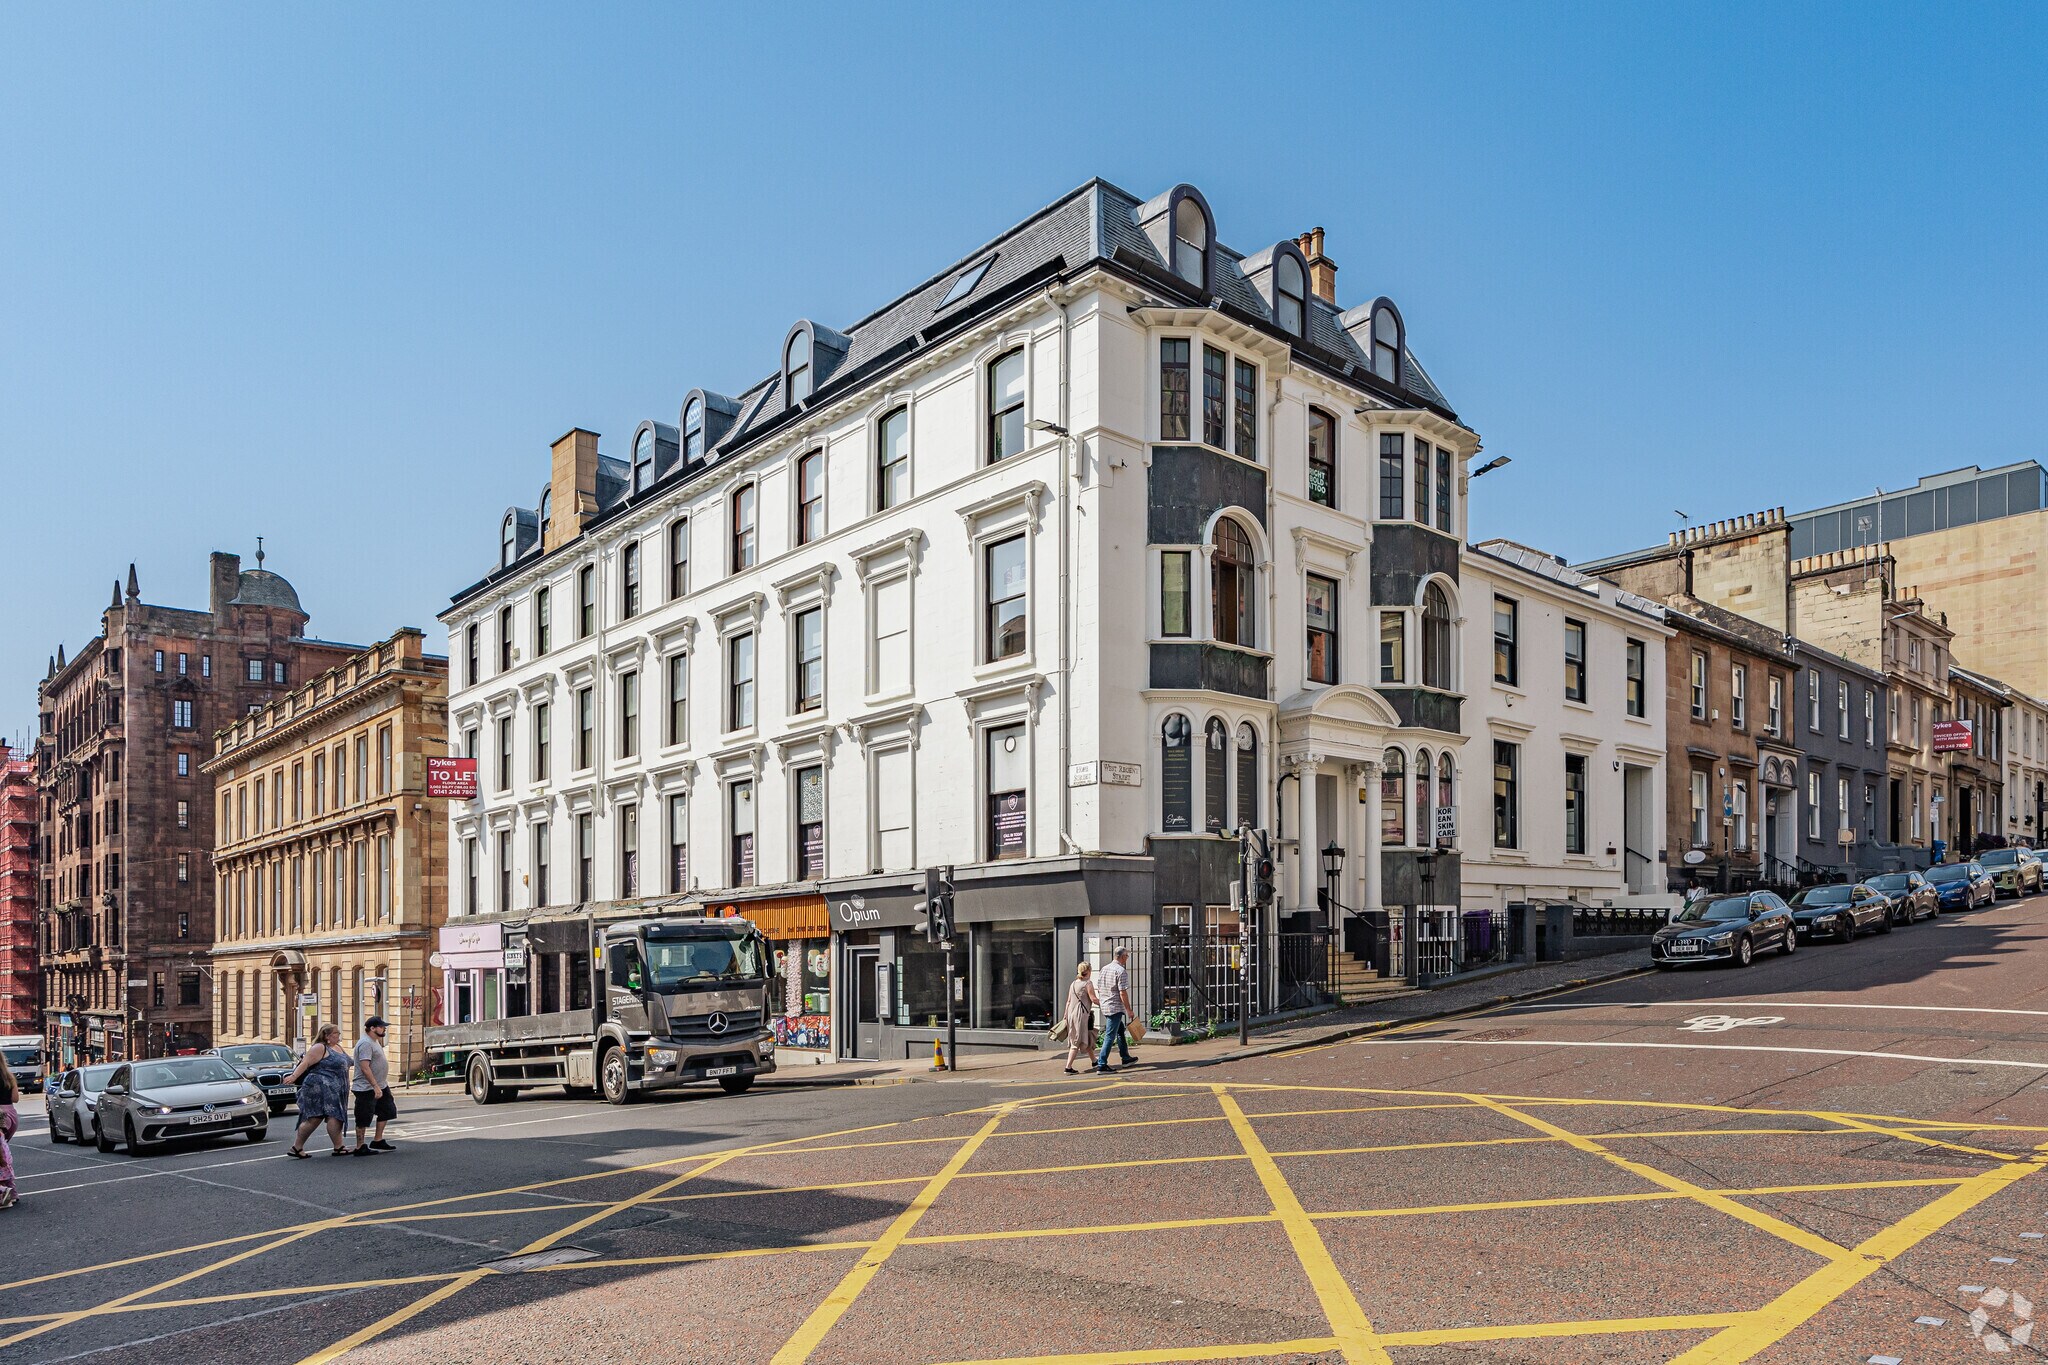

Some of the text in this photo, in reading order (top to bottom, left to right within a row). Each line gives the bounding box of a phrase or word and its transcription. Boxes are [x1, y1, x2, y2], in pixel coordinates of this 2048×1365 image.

[430, 759, 457, 767] Dykes
[1103, 764, 1117, 772] WEST
[430, 771, 477, 781] TO LET
[1112, 773, 1131, 781] STREET
[1438, 822, 1454, 830] SKIN
[1438, 829, 1456, 837] CARE
[840, 902, 880, 927] Opium
[709, 1068, 721, 1076] BN17
[193, 1115, 213, 1123] SH25
